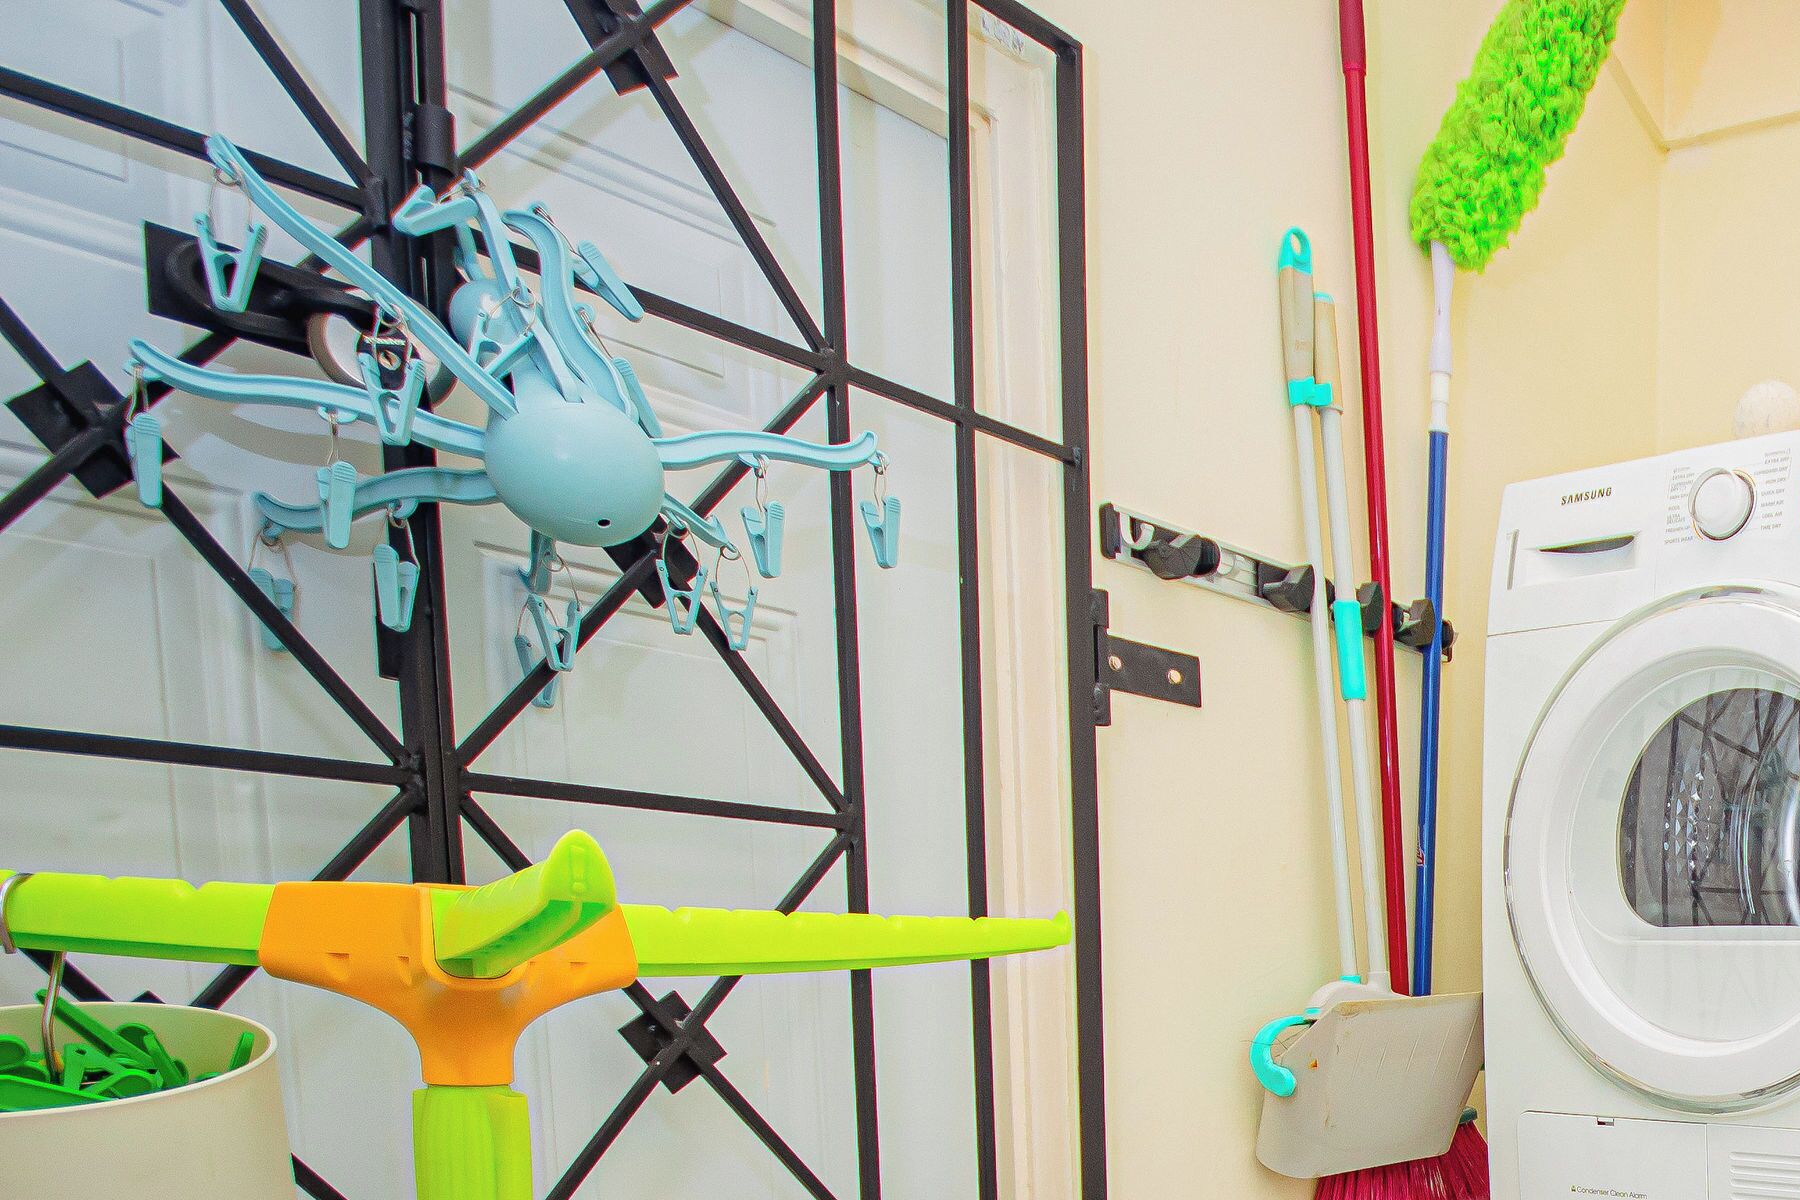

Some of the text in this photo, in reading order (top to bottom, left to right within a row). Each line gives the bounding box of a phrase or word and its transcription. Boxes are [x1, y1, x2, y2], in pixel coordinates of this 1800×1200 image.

[1561, 487, 1612, 505] SAMSUNG
[1576, 1186, 1648, 1200] Condenser Clean Alarm
